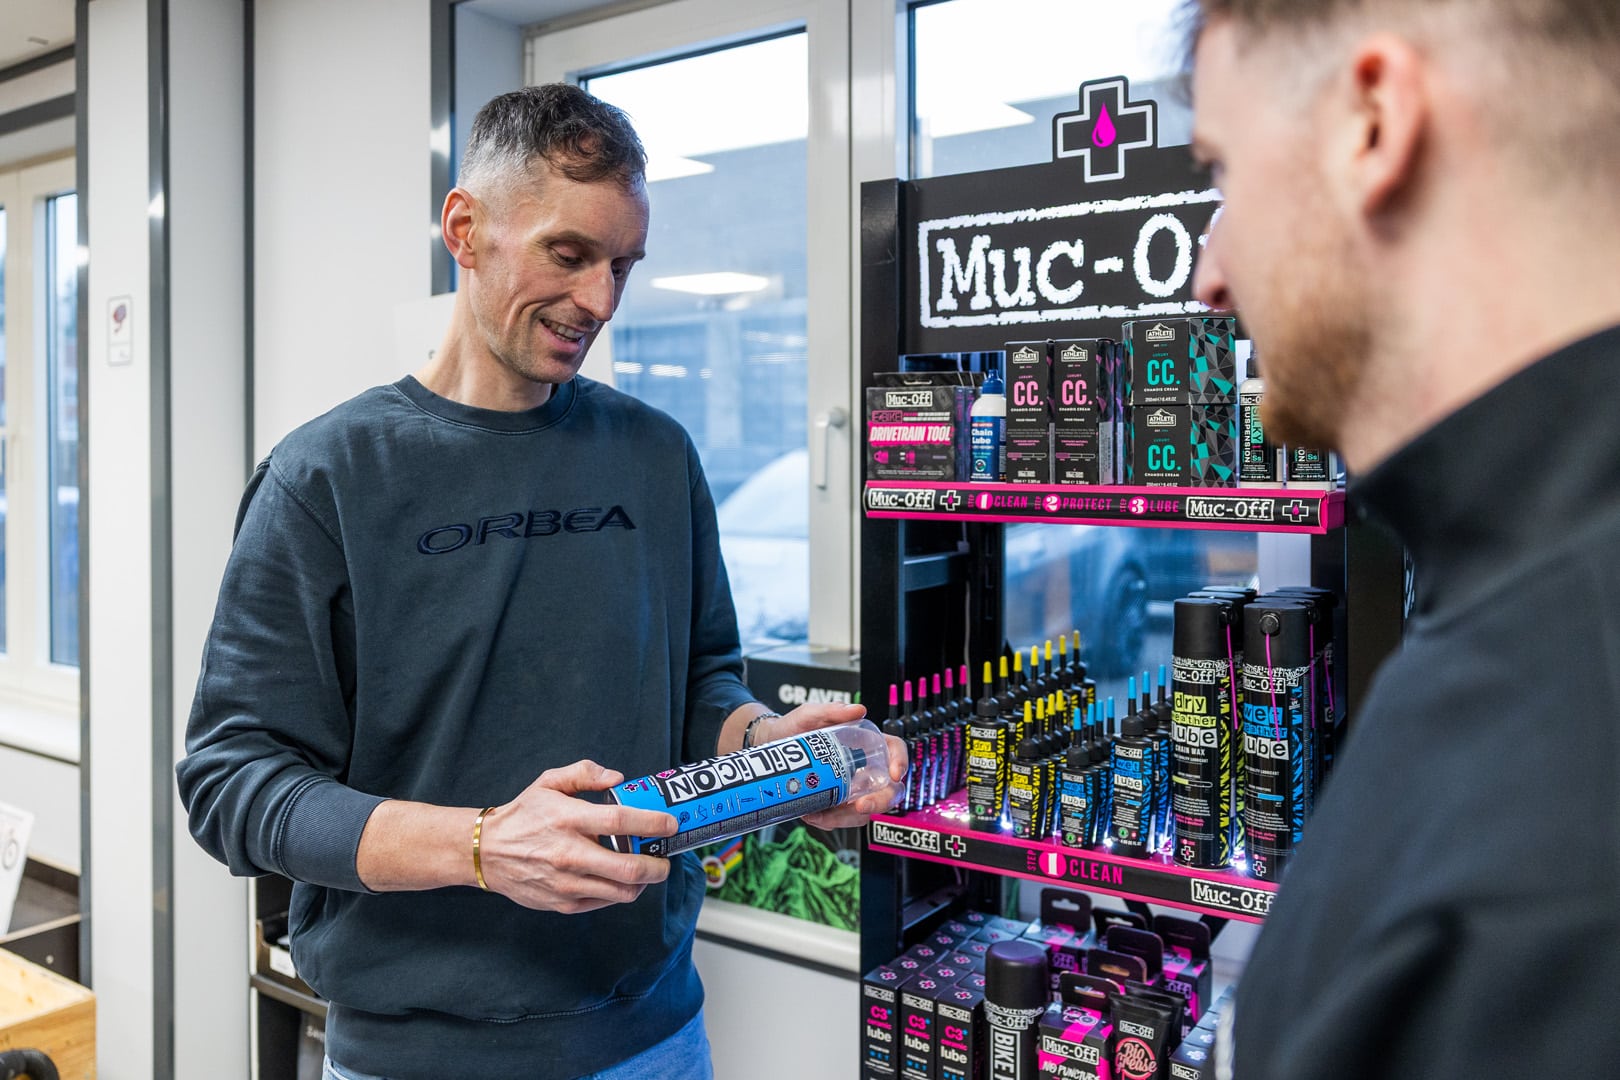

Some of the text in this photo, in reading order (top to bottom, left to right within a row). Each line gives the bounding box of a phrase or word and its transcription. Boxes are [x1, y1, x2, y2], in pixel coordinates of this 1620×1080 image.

[936, 206, 1222, 311] Muc-O
[1148, 330, 1173, 338] ATHLETE
[1063, 351, 1086, 359] ATHLETE
[1147, 359, 1181, 385] CC.
[888, 392, 930, 405] Muc-Off
[1014, 381, 1044, 406] CC.
[1061, 380, 1093, 406] CC.
[1149, 416, 1175, 424] ATHLETE
[869, 426, 951, 441] DRIVETRAIN TOOL
[1147, 444, 1182, 471] CC.
[872, 492, 932, 508] Muc-Off
[980, 494, 988, 509] 1
[994, 496, 1028, 508] CLEAN
[1046, 496, 1057, 511] 2
[1063, 497, 1111, 511] PROTECT
[1132, 498, 1144, 513] 3
[1151, 499, 1179, 513] LUBE
[1190, 501, 1270, 519] Muc-Off
[417, 505, 636, 554] ORBEA
[1245, 679, 1284, 692] uc-Off
[1176, 692, 1205, 711] dry
[1244, 705, 1281, 723] wet
[1172, 723, 1214, 744] lube
[1245, 724, 1287, 737] eather
[974, 740, 991, 751] dry
[1175, 744, 1206, 756] CHAIN WAX
[1247, 735, 1286, 757] ube
[970, 756, 996, 769] lube
[1117, 761, 1140, 771] wet
[1115, 774, 1142, 790] lube
[1010, 786, 1032, 799] lube
[1061, 794, 1086, 807] lube
[876, 826, 937, 849] Muc-Off
[1027, 850, 1123, 884] STEP 1 CLEAN
[1195, 883, 1275, 913] Muc-Off
[870, 1005, 888, 1020] C3
[908, 1015, 926, 1030] C3
[1120, 1021, 1153, 1038] Muc-Off
[866, 1025, 892, 1042] lube
[944, 1025, 963, 1041] C3
[904, 1034, 930, 1052] lube
[1045, 1039, 1098, 1060] Muc-Off
[1123, 1042, 1145, 1059] Bio
[940, 1046, 968, 1064] lube
[994, 1032, 1014, 1073] BIKE
[1042, 1060, 1058, 1073] NO
[1115, 1052, 1157, 1073] Grease
